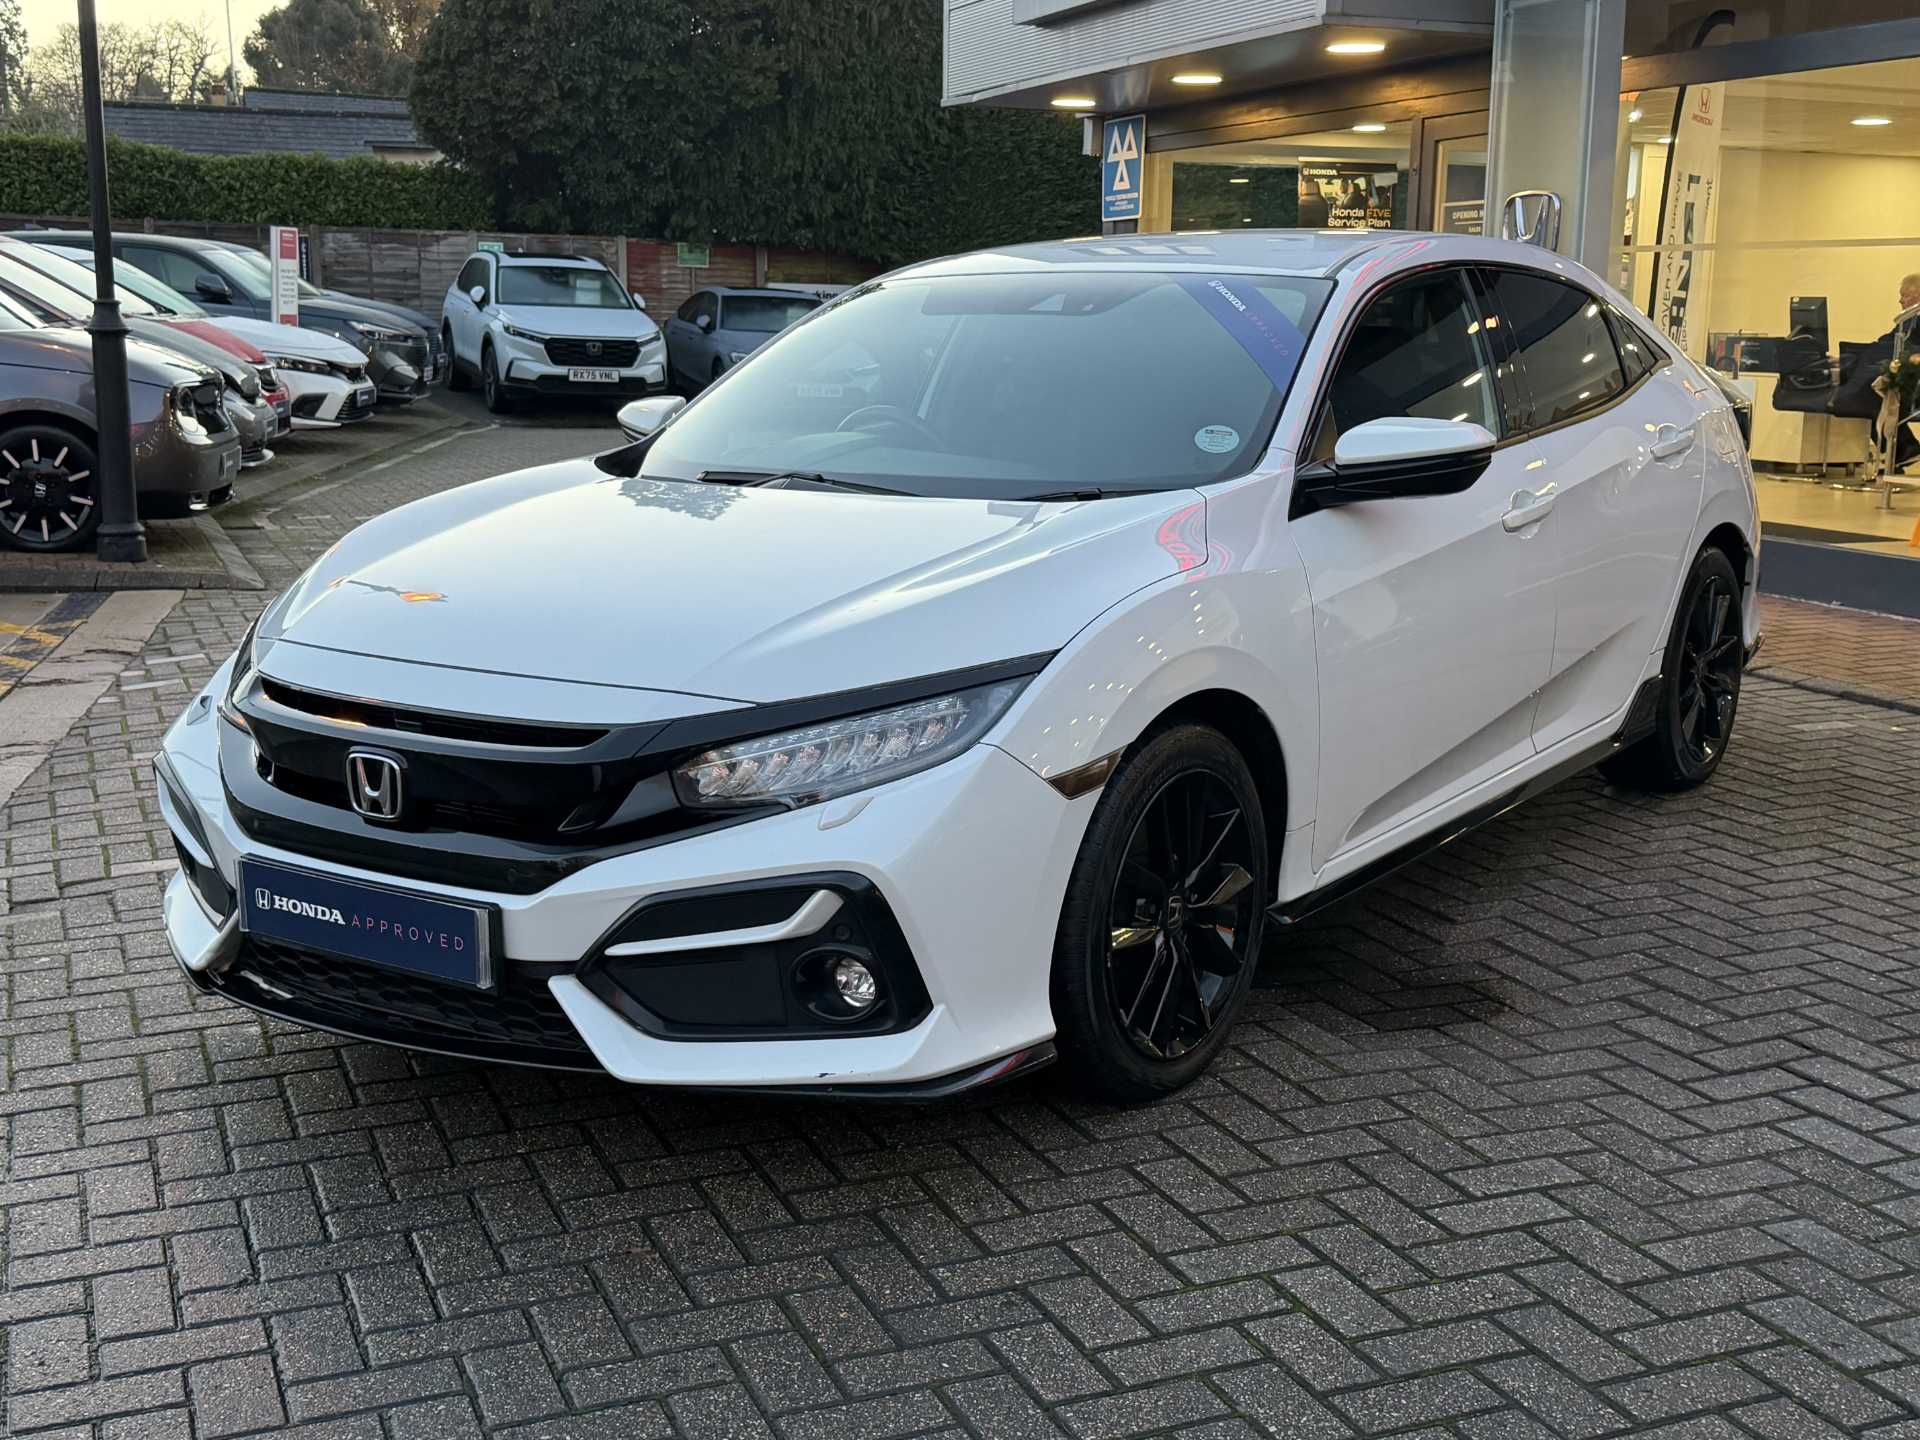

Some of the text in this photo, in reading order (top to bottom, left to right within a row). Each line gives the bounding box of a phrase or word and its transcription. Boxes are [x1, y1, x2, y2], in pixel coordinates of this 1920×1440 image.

[1331, 207, 1391, 217] Honda FIVE
[1328, 217, 1391, 228] Service Plan
[1214, 284, 1247, 312] HONDA
[273, 895, 464, 951] HONDA APPROVED
